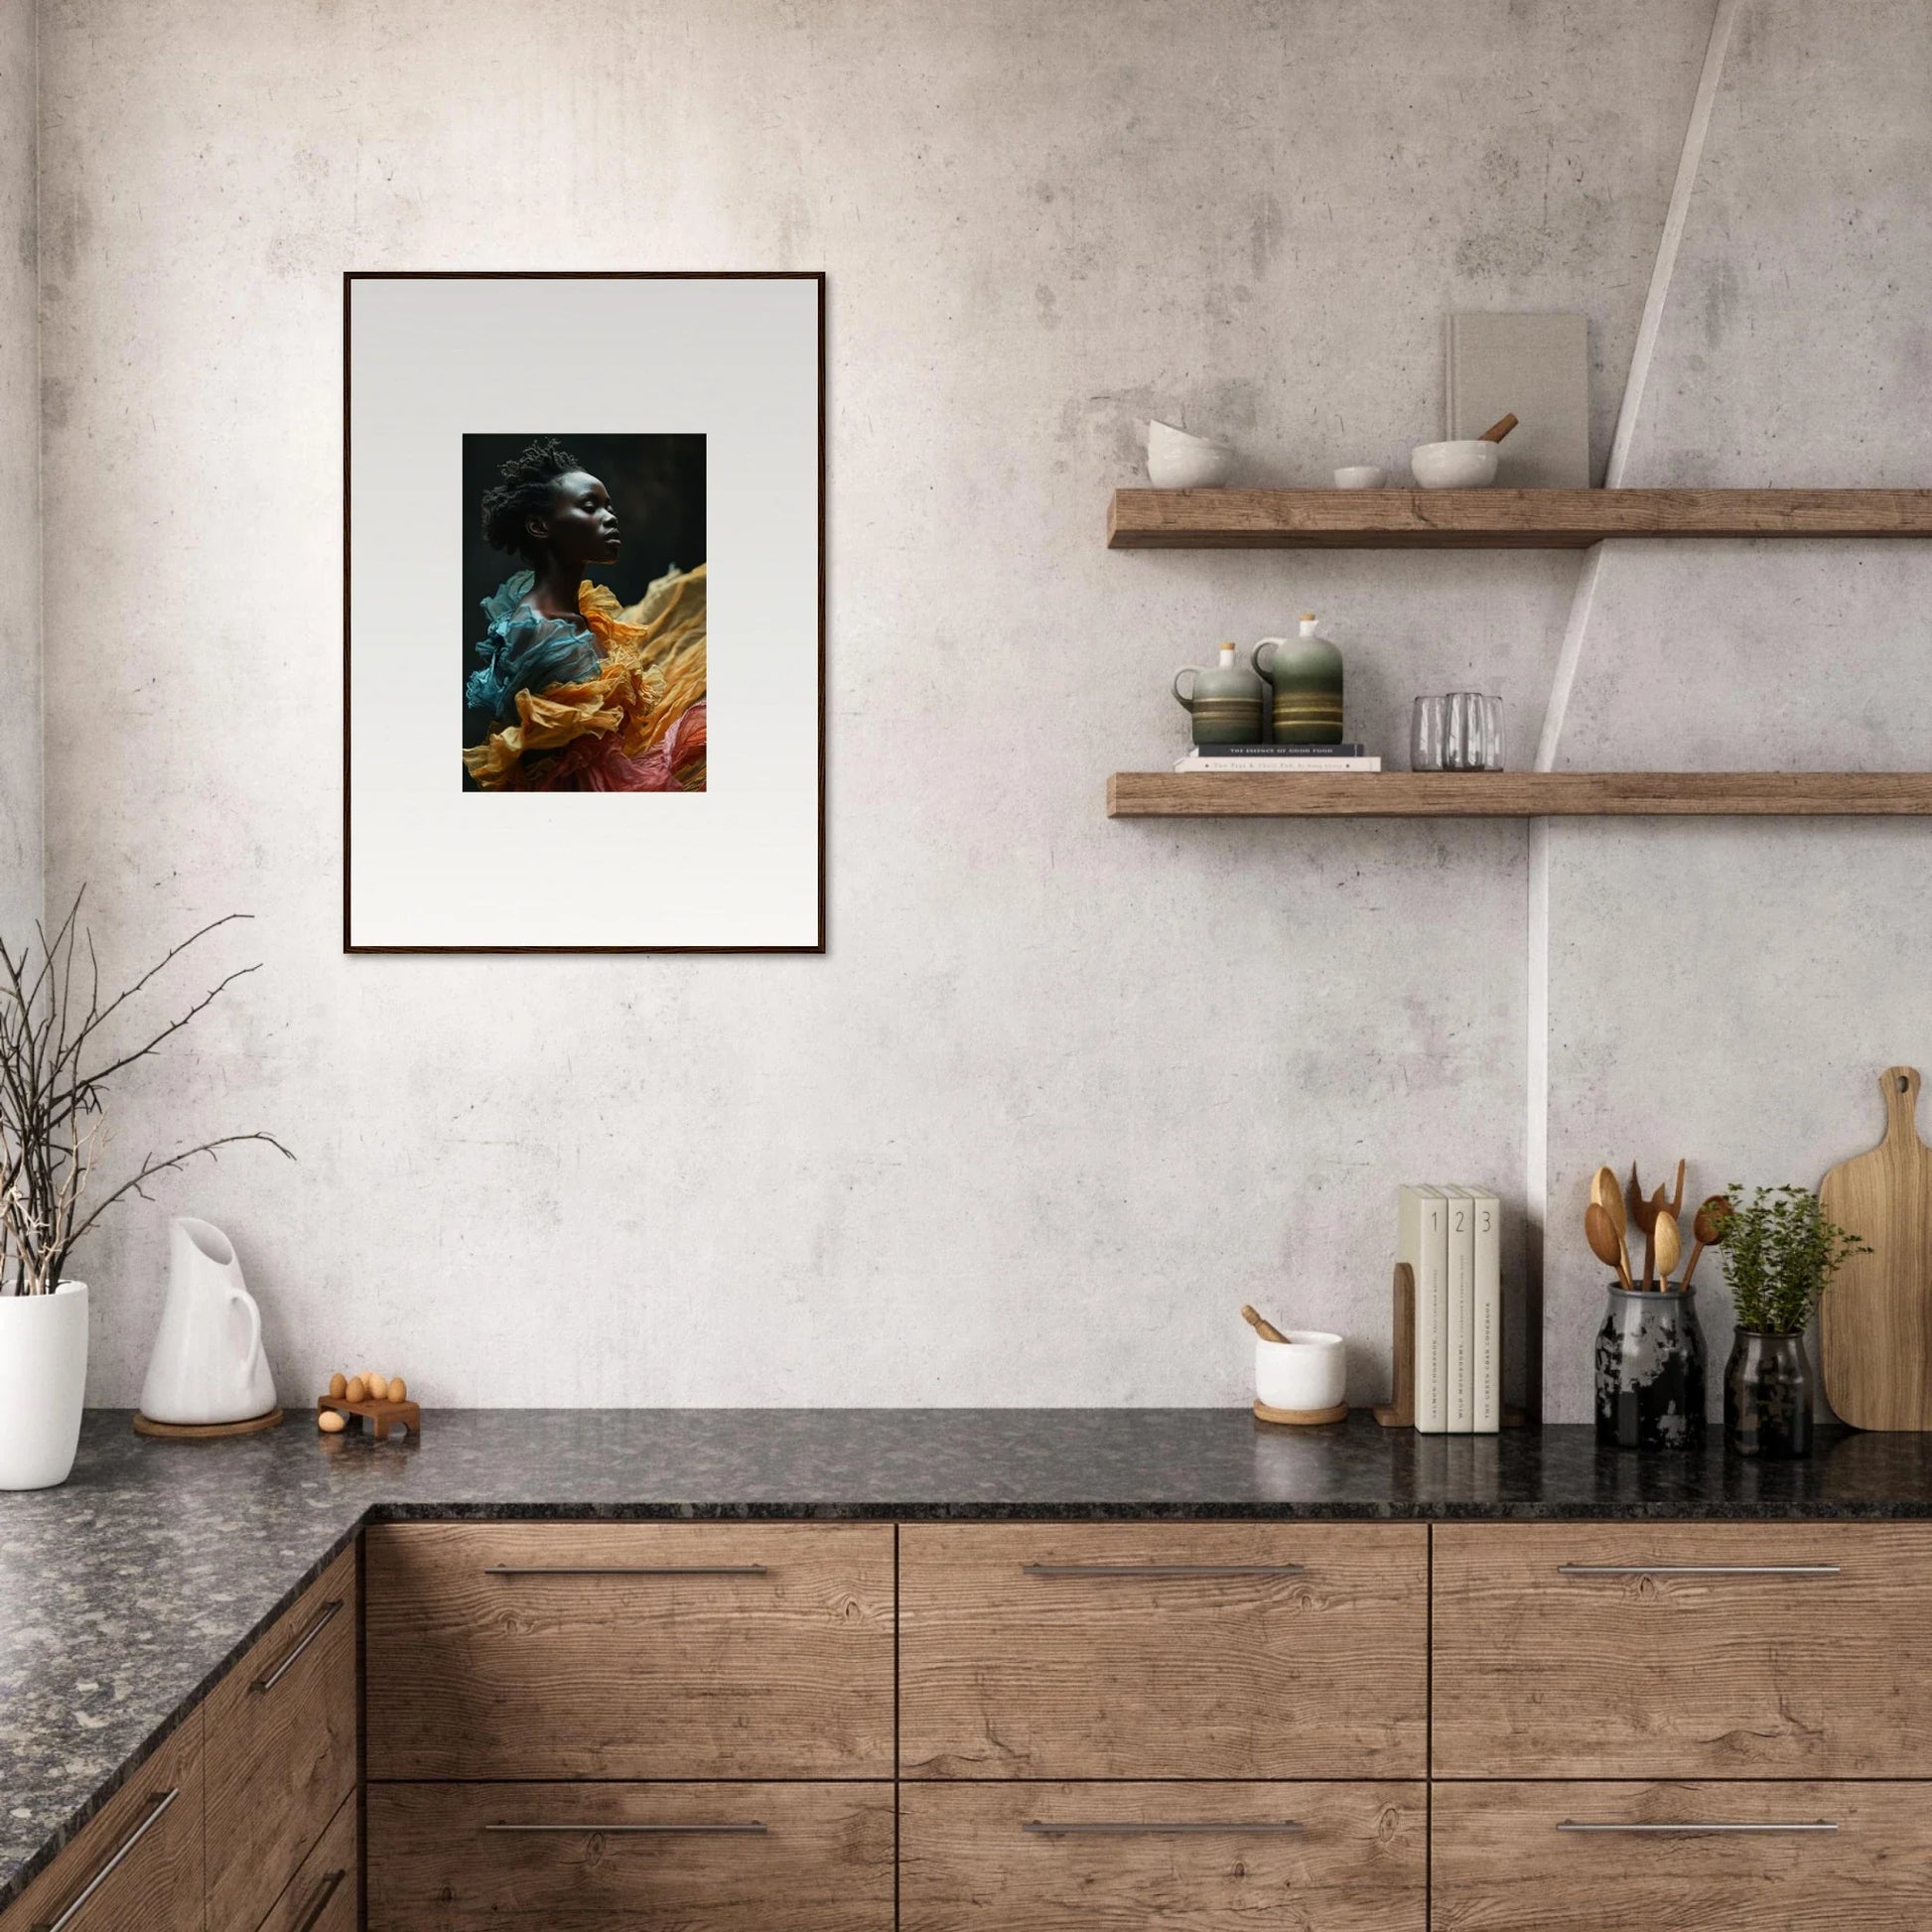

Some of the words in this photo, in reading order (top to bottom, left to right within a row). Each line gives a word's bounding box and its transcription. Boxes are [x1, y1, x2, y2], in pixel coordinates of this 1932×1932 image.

[1431, 1211, 1438, 1232] 1
[1455, 1211, 1464, 1232] 2
[1482, 1211, 1491, 1232] 3
